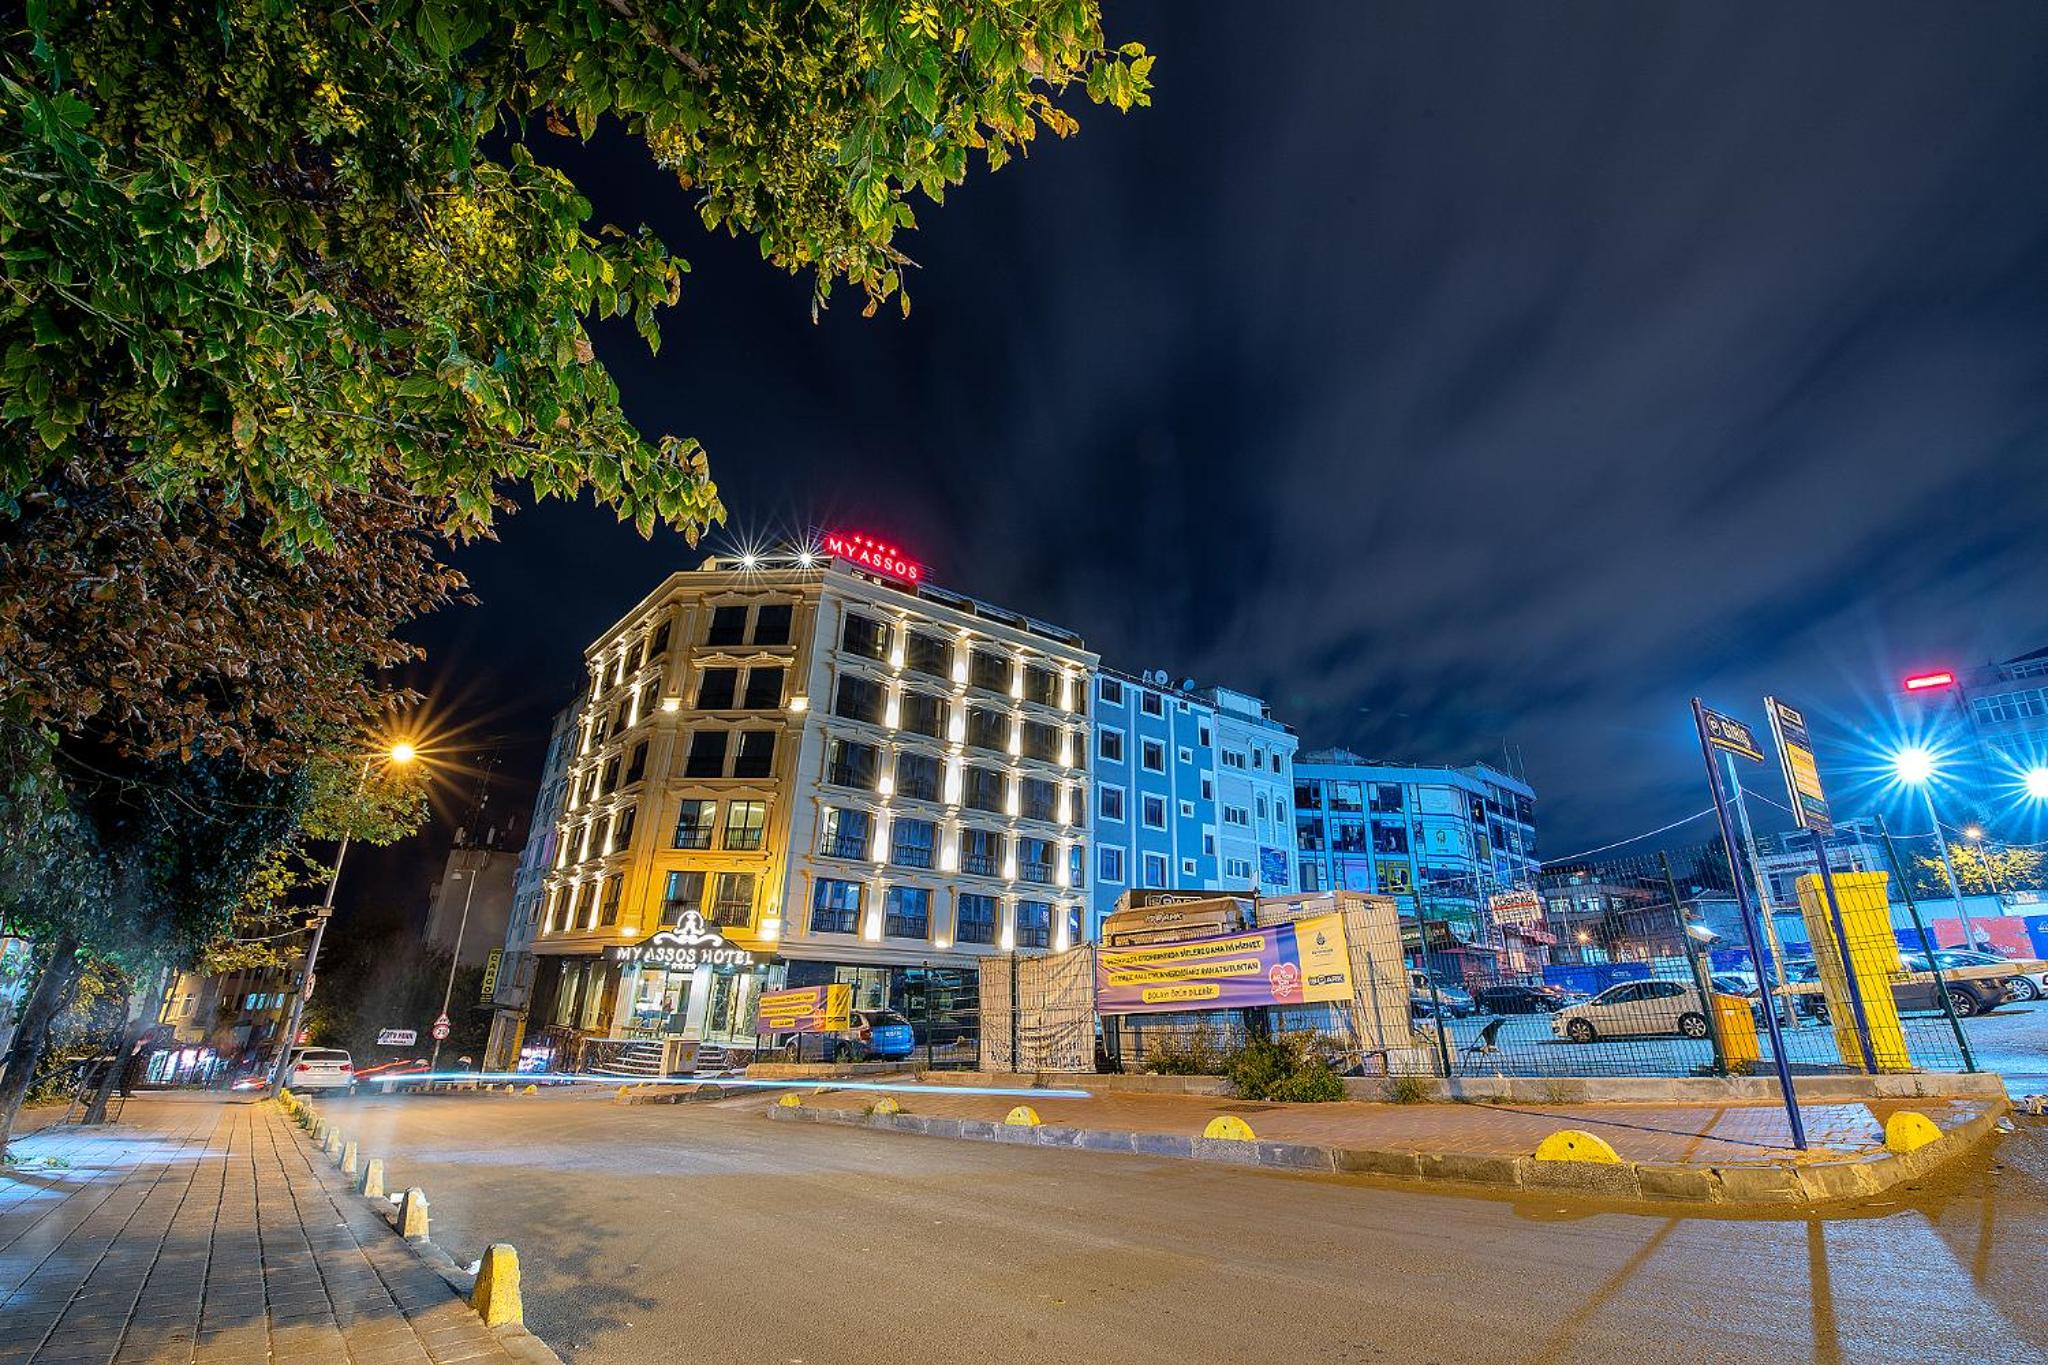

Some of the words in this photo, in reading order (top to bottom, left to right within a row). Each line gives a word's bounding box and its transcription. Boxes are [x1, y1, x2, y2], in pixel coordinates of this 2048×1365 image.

[830, 539, 856, 558] MY
[860, 550, 918, 578] ASSOS
[617, 947, 642, 960] MY
[644, 948, 696, 963] ASSOS
[701, 949, 754, 965] HOTEL
